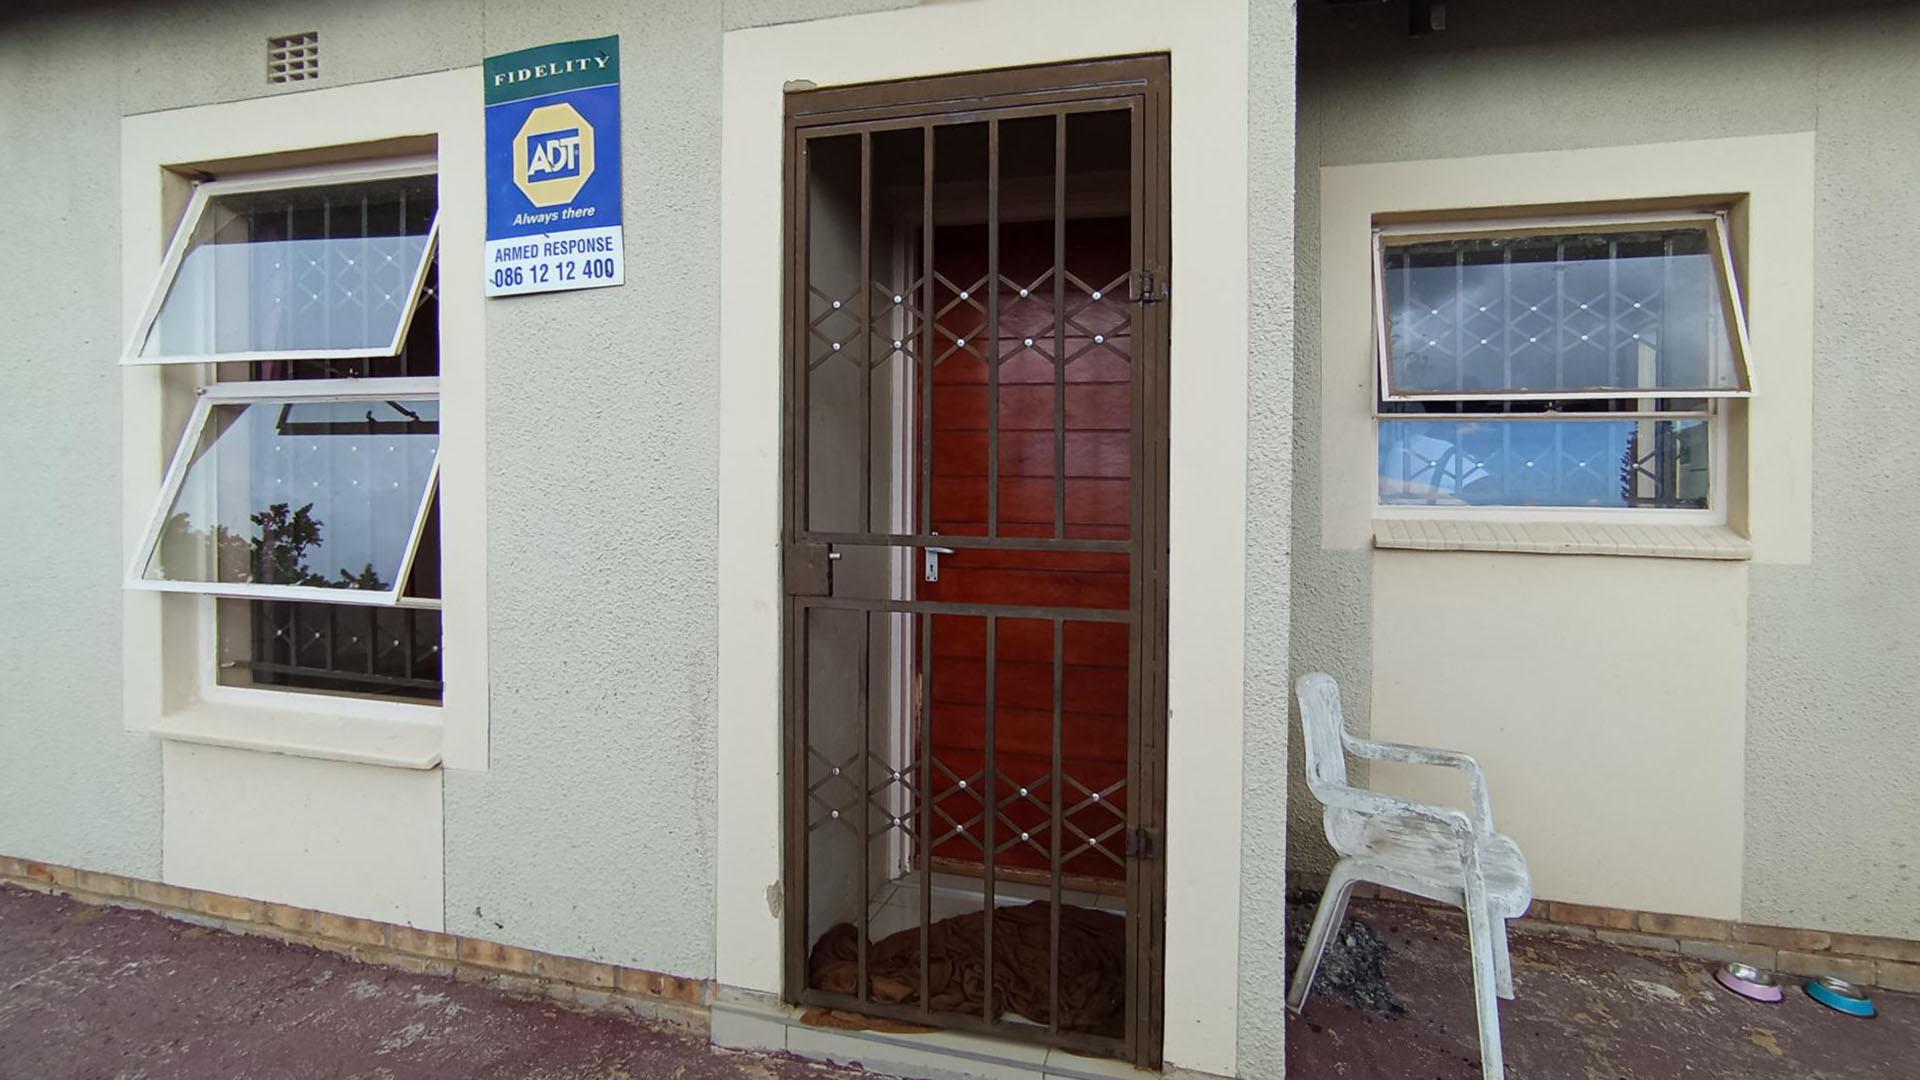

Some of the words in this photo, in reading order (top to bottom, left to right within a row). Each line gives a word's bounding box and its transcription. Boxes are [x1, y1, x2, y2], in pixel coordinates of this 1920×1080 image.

[495, 55, 610, 87] FIDELITY
[527, 136, 580, 176] ADT
[512, 210, 559, 226] Always
[562, 206, 596, 220] there
[495, 244, 539, 262] ARMED
[544, 236, 614, 257] RESPONSE
[494, 266, 523, 288] 086
[530, 263, 549, 284] 12
[555, 261, 576, 281] 12
[582, 258, 615, 279] 400
